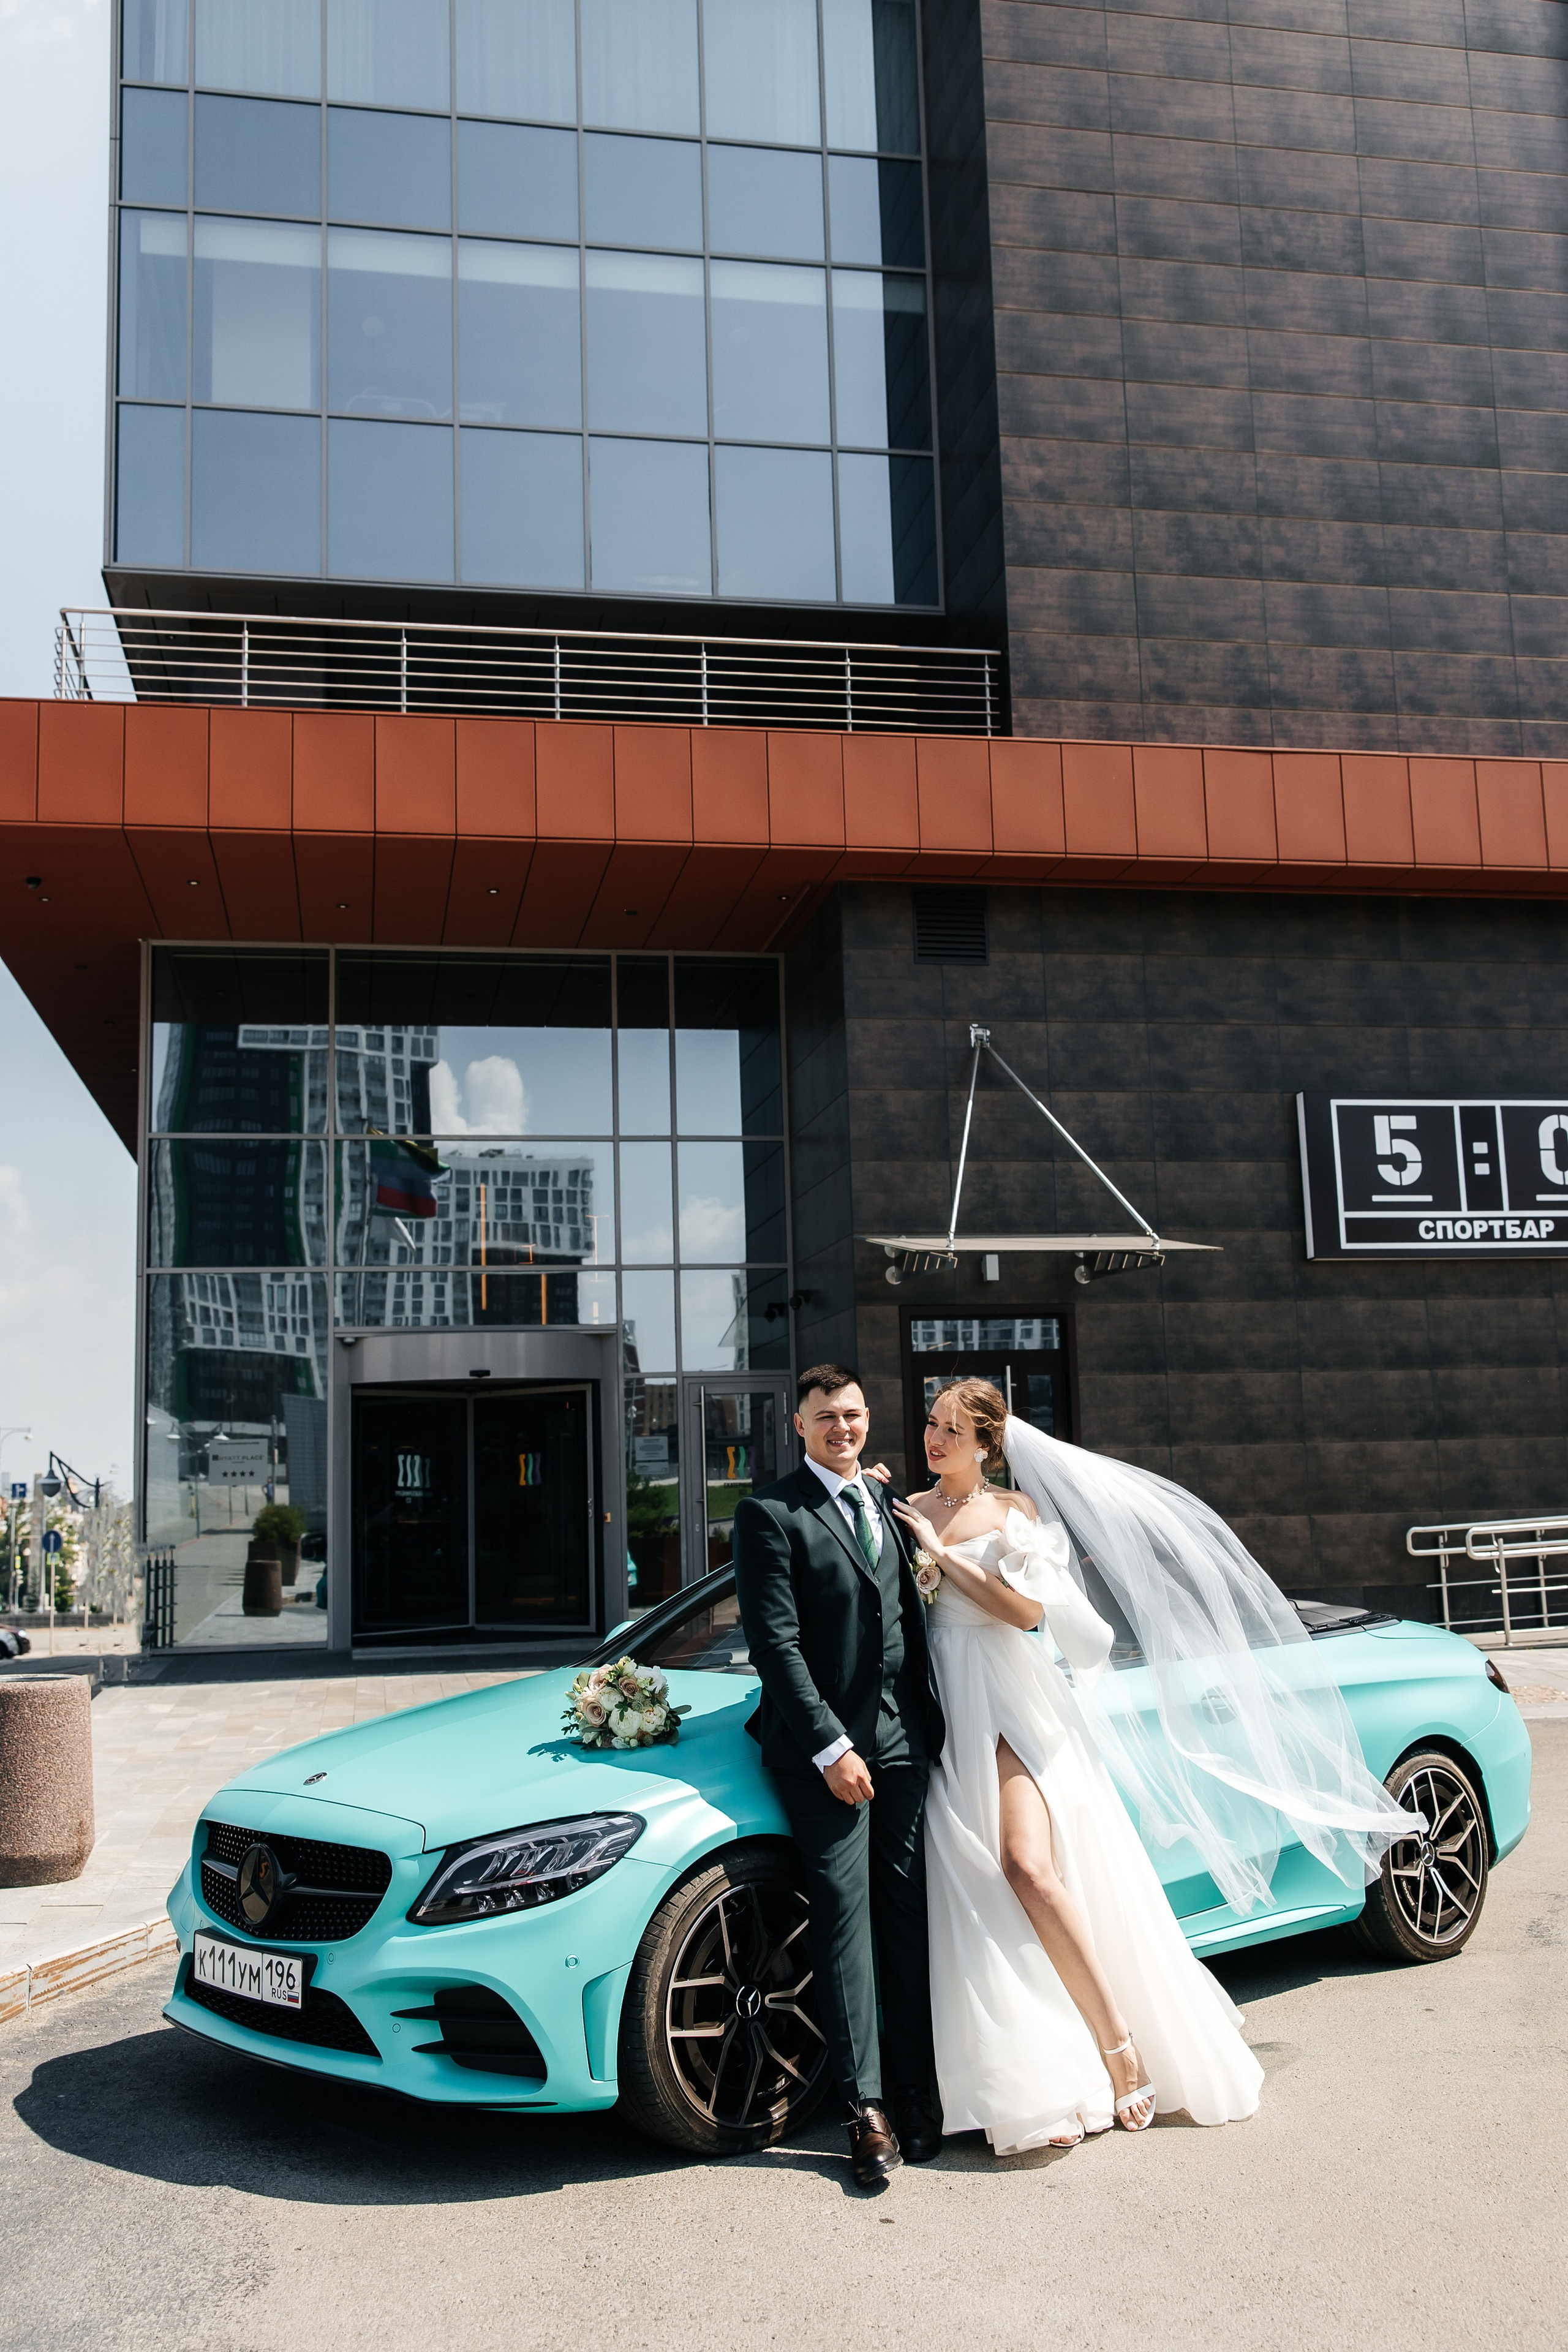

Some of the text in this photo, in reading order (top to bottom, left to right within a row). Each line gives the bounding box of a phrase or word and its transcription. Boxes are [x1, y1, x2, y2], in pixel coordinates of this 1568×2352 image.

[1373, 1115, 1422, 1186] 5
[1419, 1219, 1555, 1240] СПОРТБАР
[265, 1959, 296, 1990] 196
[271, 1988, 287, 2000] RUS
